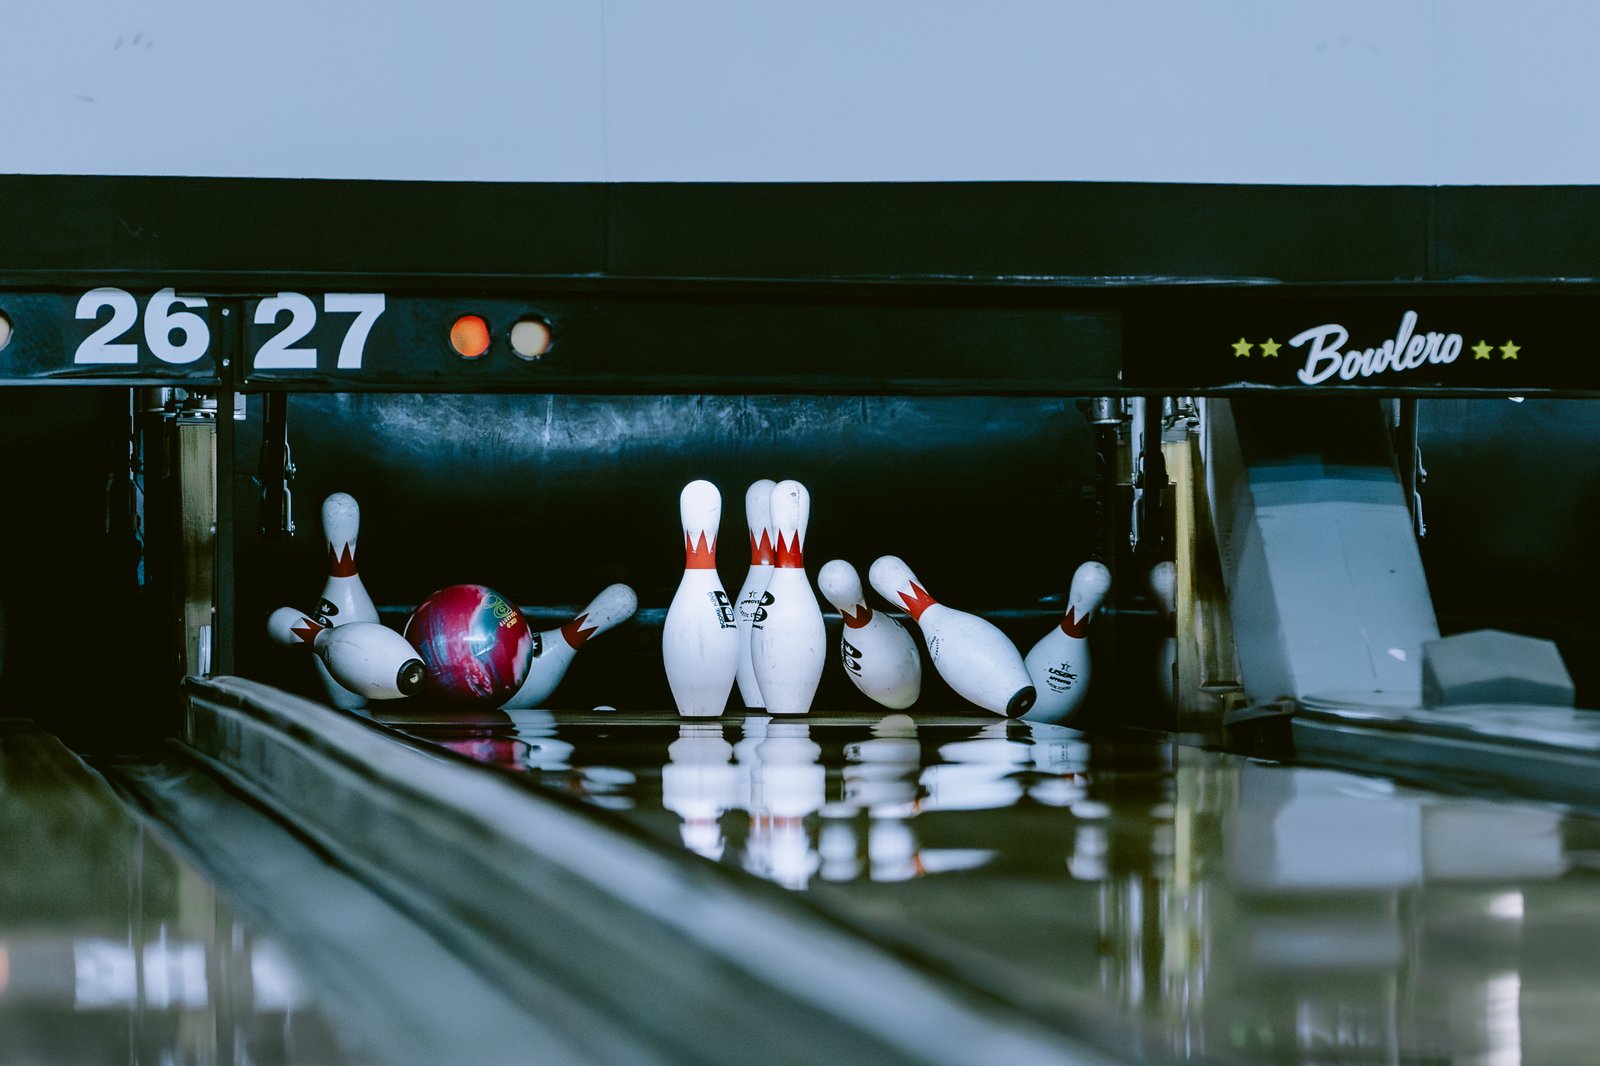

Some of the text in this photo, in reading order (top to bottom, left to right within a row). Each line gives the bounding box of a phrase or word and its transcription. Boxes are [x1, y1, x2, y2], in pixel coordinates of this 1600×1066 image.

[74, 287, 209, 364] 26
[253, 292, 387, 369] 27
[1288, 310, 1463, 385] Bowlero
